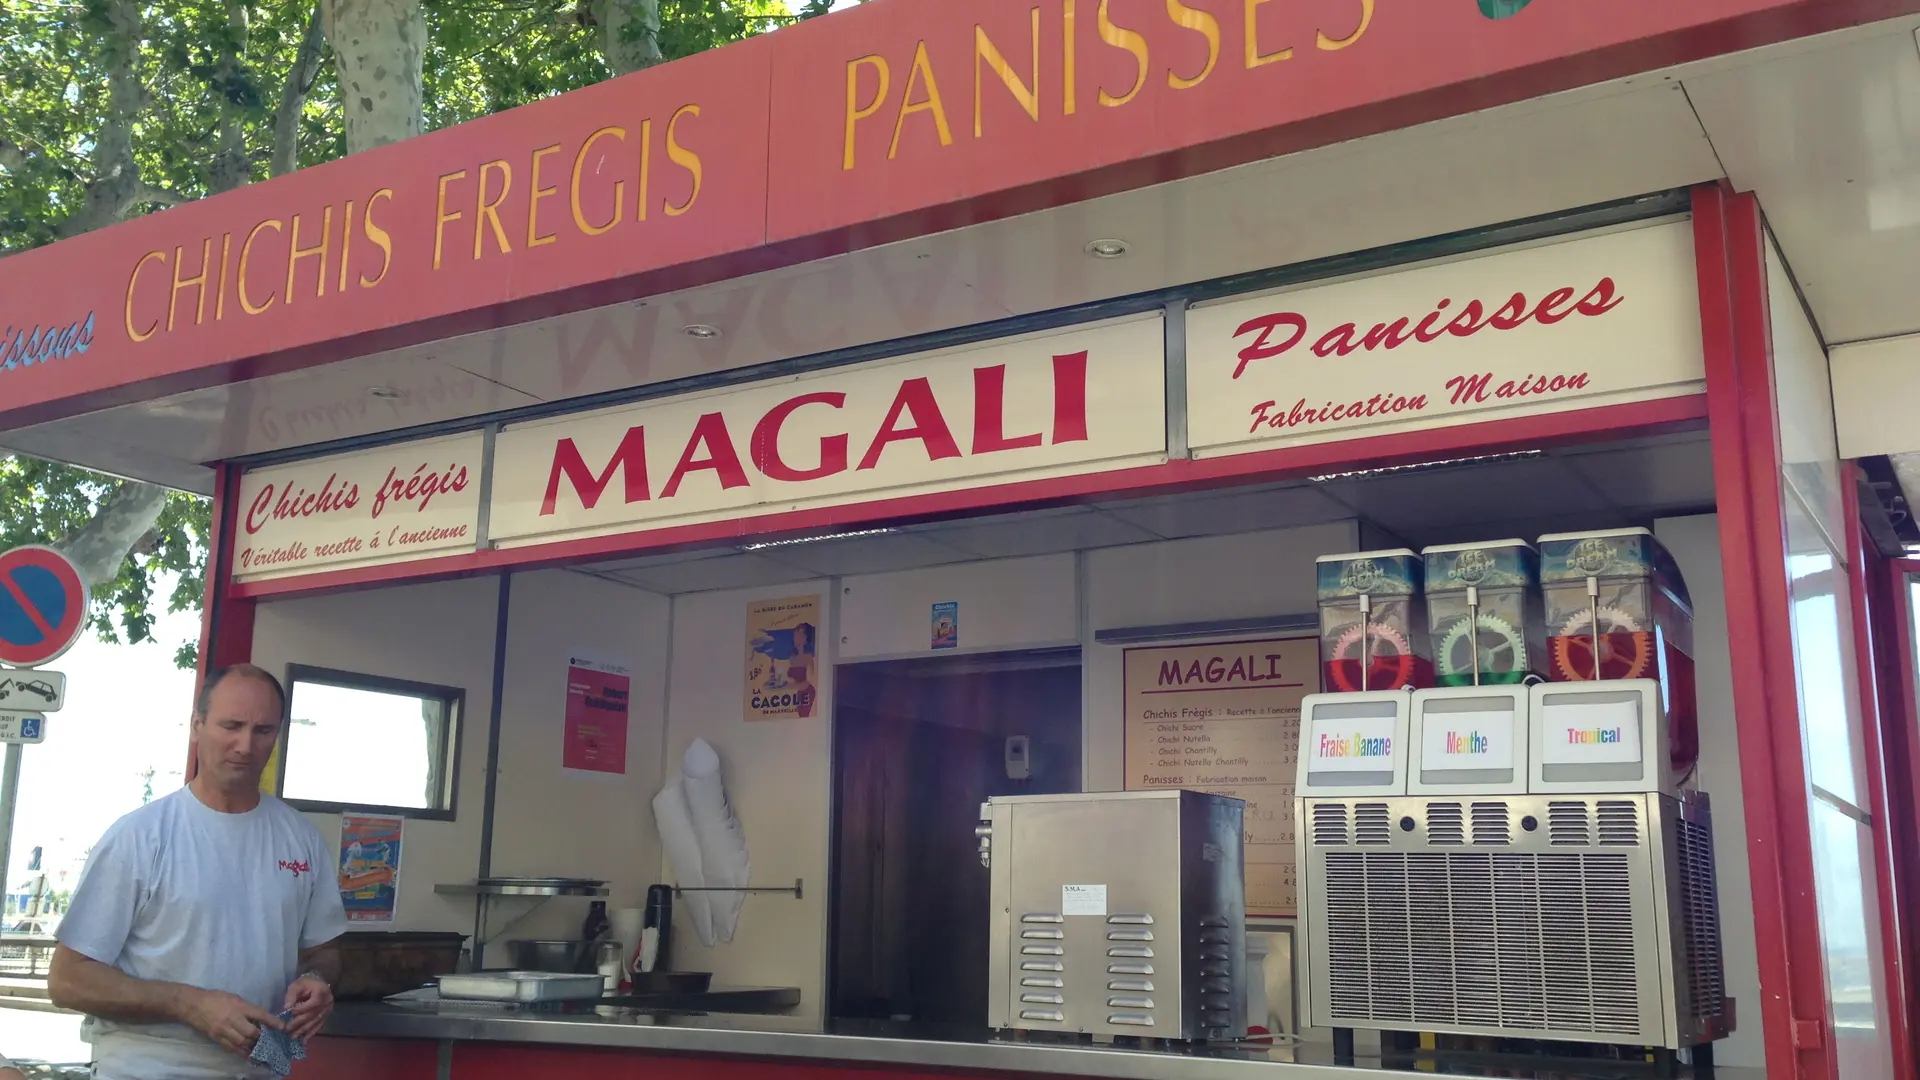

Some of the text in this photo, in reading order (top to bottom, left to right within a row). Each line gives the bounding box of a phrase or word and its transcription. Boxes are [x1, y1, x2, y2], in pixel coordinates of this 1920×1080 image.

[125, 189, 393, 342] CHICHIS
[433, 104, 703, 271] FREGIS
[1231, 277, 1625, 380] Panisses
[1249, 370, 1590, 433] Fabrication Maison
[541, 350, 1087, 516] MAGALI
[245, 462, 469, 535] Chichis frégis
[241, 542, 308, 568] Véritable
[314, 536, 362, 557] recette
[388, 523, 467, 547] l'ancienne
[1158, 654, 1282, 686] MAGALI
[751, 692, 810, 709] CAGOLE
[1143, 709, 1177, 719] Chichis
[1157, 724, 1179, 732] Chichi
[1157, 735, 1180, 744] Chichi
[1184, 735, 1211, 743] Nutella
[1158, 747, 1181, 756] Chichi
[1184, 746, 1218, 756] Chantilly
[1320, 732, 1391, 758] Fraise Banane
[1446, 730, 1488, 755] Menthe
[1158, 758, 1181, 767] Chichi
[1184, 758, 1212, 767] Nutella
[1215, 757, 1249, 767] Chantilly
[1143, 775, 1183, 784] Panisses
[1241, 775, 1267, 783] maison
